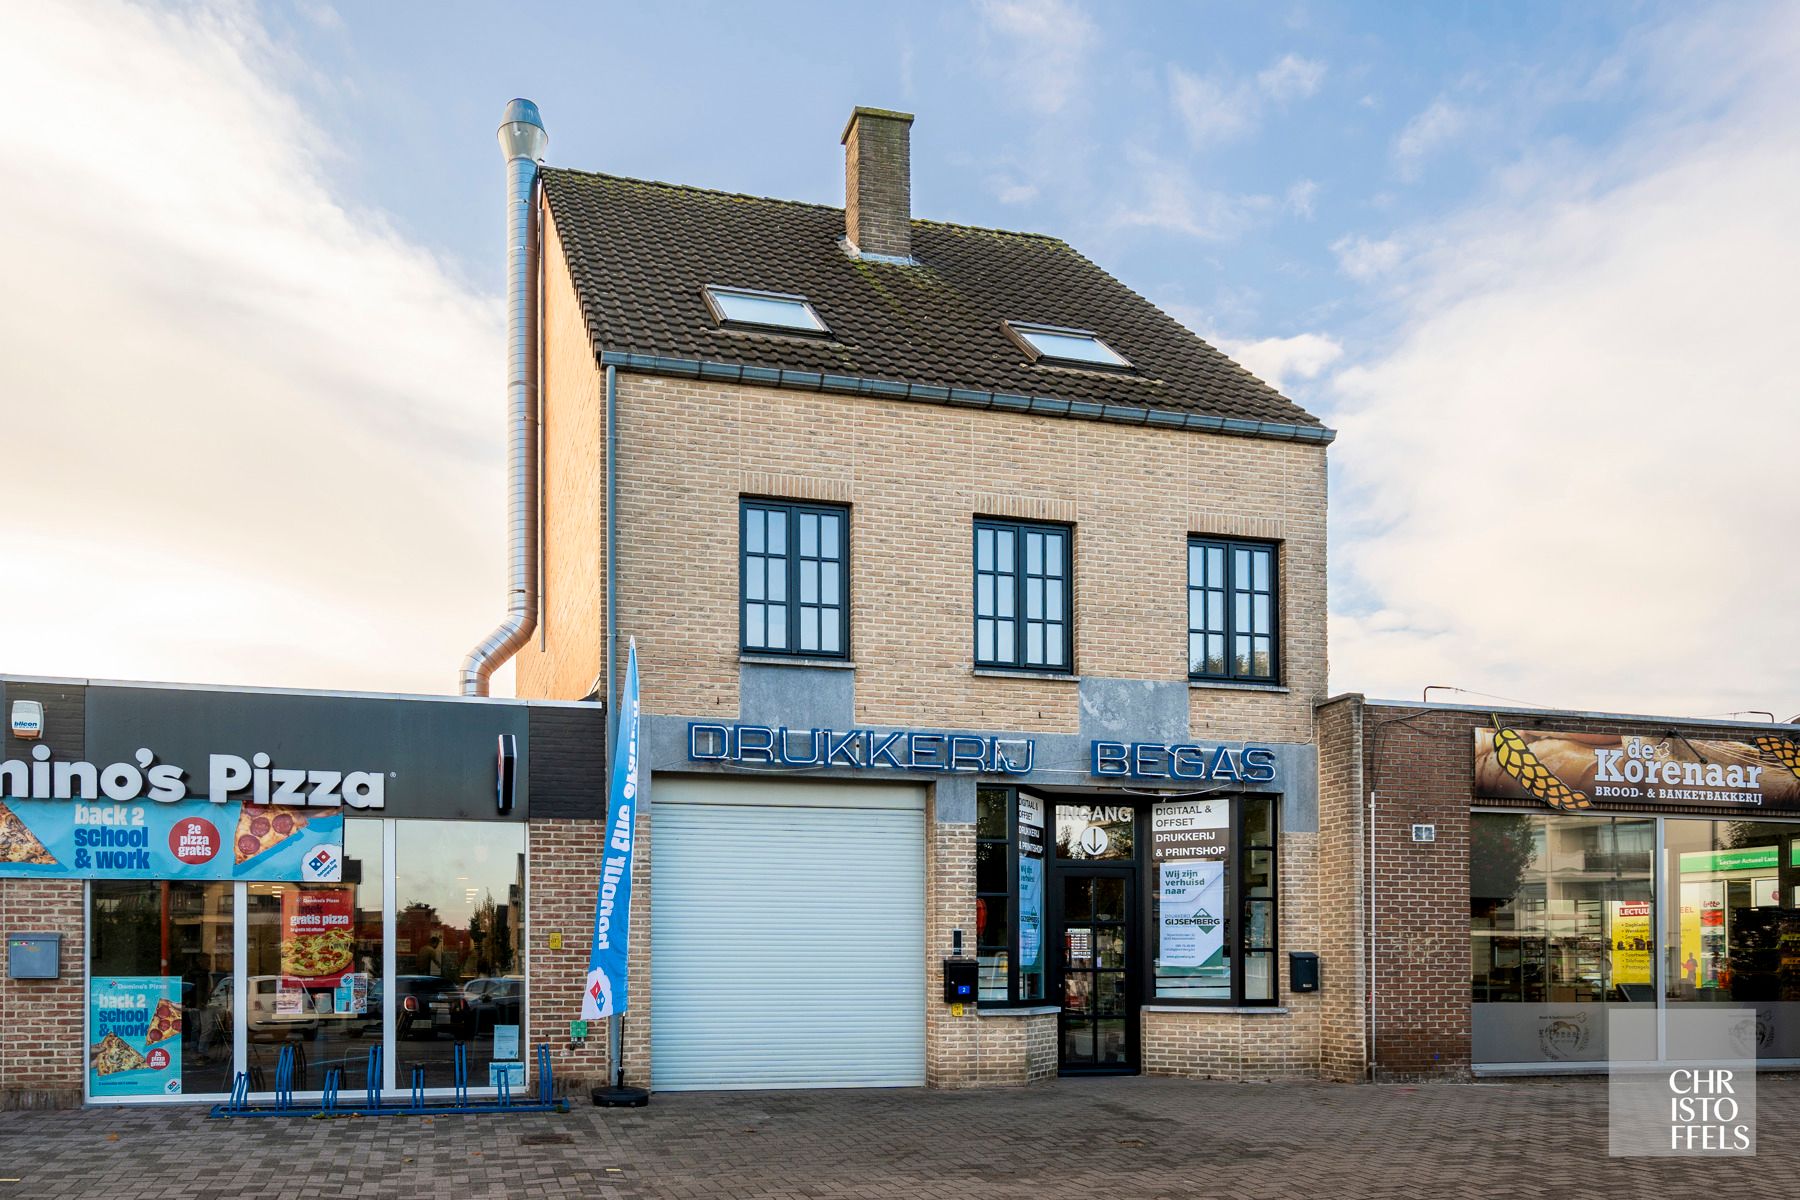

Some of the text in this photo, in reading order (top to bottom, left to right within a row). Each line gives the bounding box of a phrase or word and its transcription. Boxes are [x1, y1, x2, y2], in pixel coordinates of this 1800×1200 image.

[688, 722, 1276, 784] DRUKKERIJ BEGAS
[1627, 738, 1655, 760] de
[1594, 749, 1763, 789] Korenaar
[209, 752, 384, 809] Pizza
[1595, 786, 1763, 805] BROOD- & BANKETBAKKERIJ
[74, 804, 145, 826] back 2
[1057, 805, 1133, 822] INGANG
[1155, 804, 1212, 816] DIGITAAL &
[187, 823, 201, 834] 2e
[1155, 817, 1195, 828] OFFSET
[74, 826, 148, 848] school
[180, 834, 209, 846] pizza
[1155, 831, 1216, 843] DRUKKERIJ
[178, 845, 212, 857] gratis
[1155, 845, 1226, 857] & PRINTSHOP
[74, 848, 149, 870] & work
[1165, 869, 1198, 880] Wij zijn
[1165, 878, 1205, 887] verhuisd
[290, 914, 349, 926] gratis pizza
[1164, 918, 1220, 926] GIJSEMBERG
[99, 993, 146, 1009] back 2
[99, 1007, 148, 1022] school
[99, 1023, 149, 1037] & work
